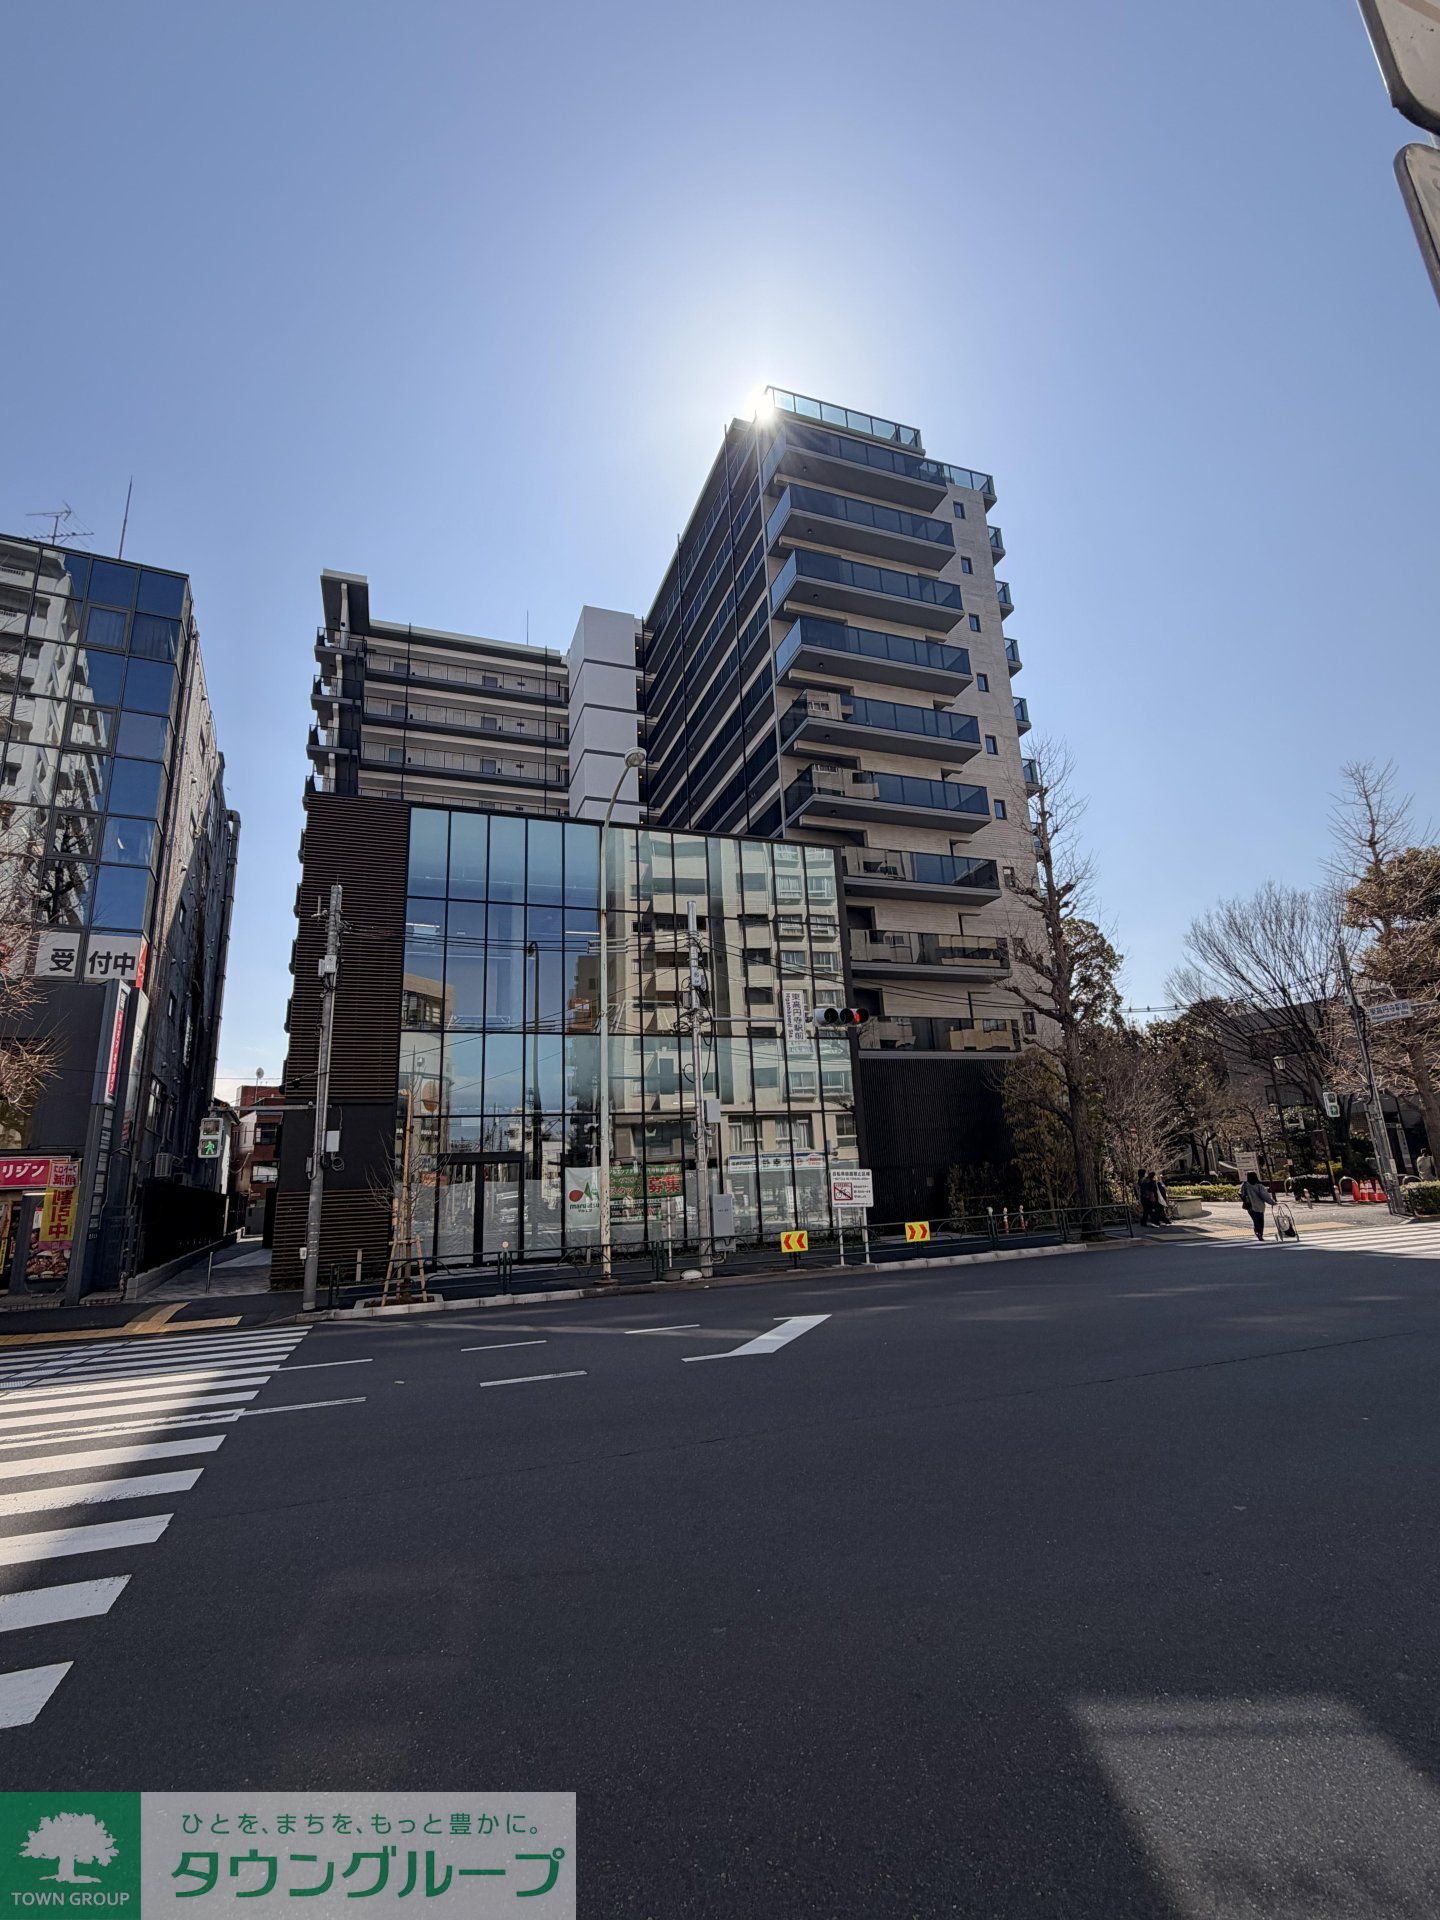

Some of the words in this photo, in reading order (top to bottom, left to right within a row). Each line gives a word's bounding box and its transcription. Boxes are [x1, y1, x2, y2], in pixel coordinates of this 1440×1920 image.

[49, 948, 136, 976] 受付中
[648, 1175, 680, 1194] 募集
